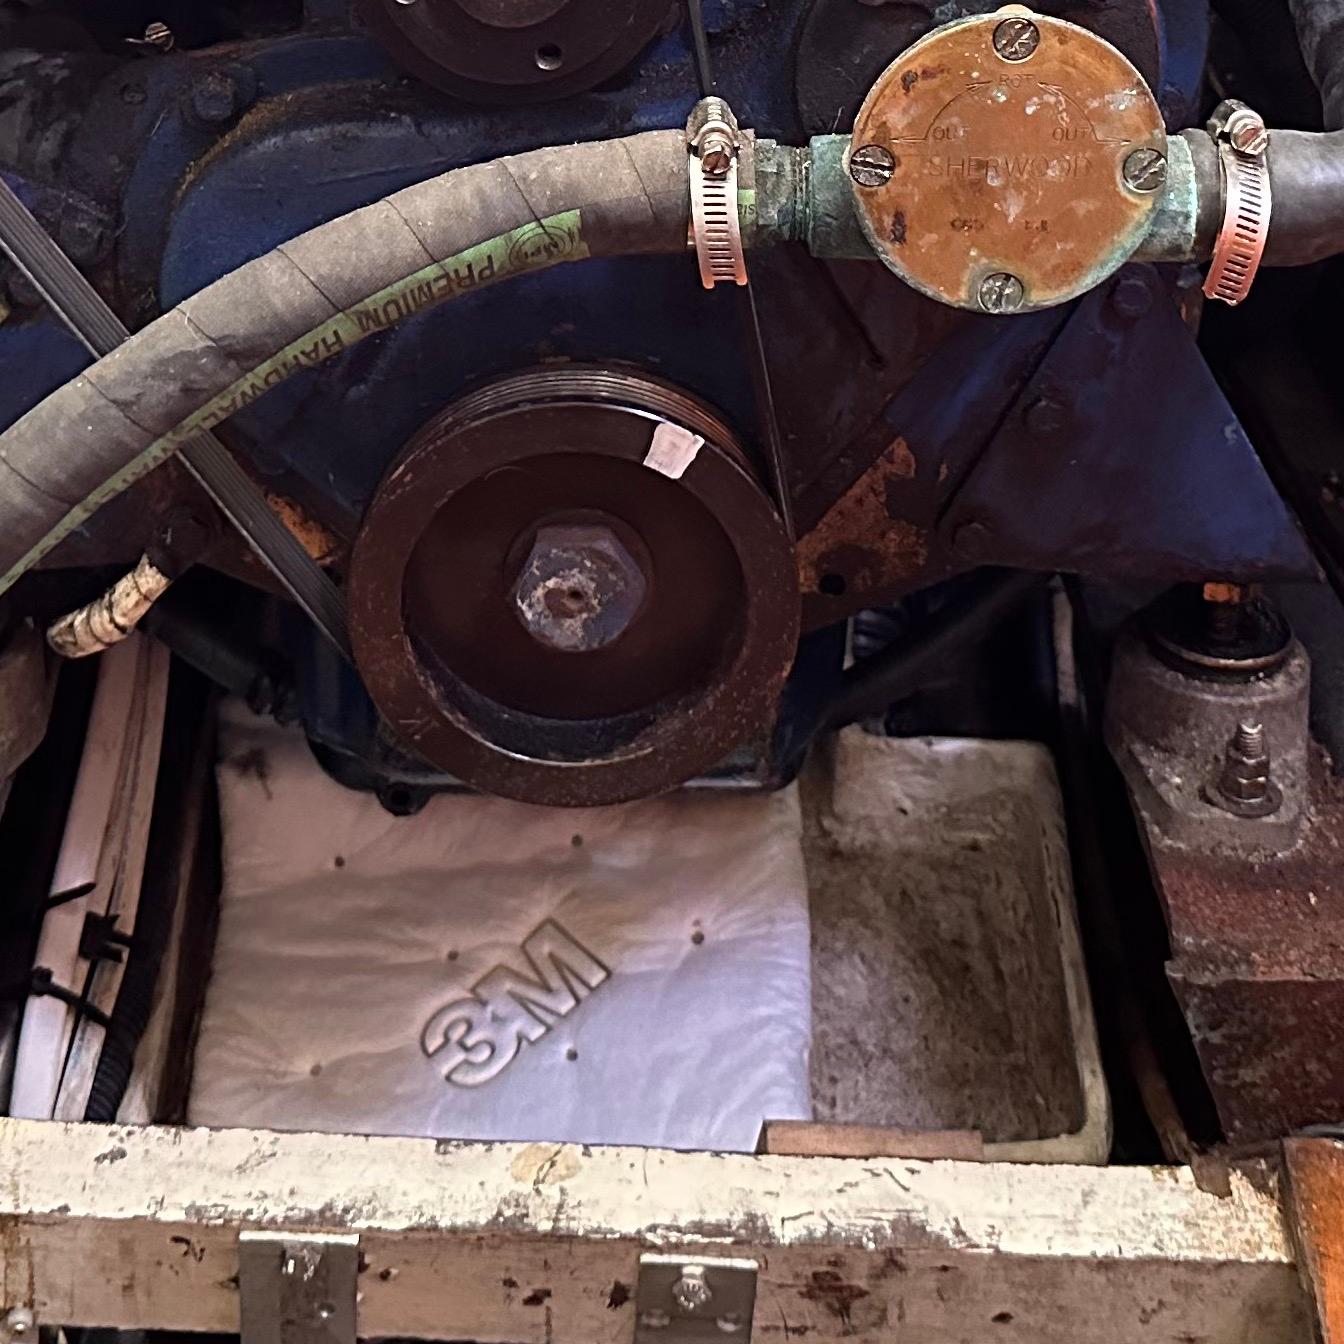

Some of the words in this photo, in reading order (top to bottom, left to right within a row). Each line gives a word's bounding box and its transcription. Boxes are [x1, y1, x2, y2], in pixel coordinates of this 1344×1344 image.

[932, 126, 971, 142] OUT
[1052, 127, 1090, 143] OUT
[927, 156, 1094, 178] SHERWOOD
[357, 253, 496, 335] PREMIUM
[420, 917, 613, 1089] 3M
